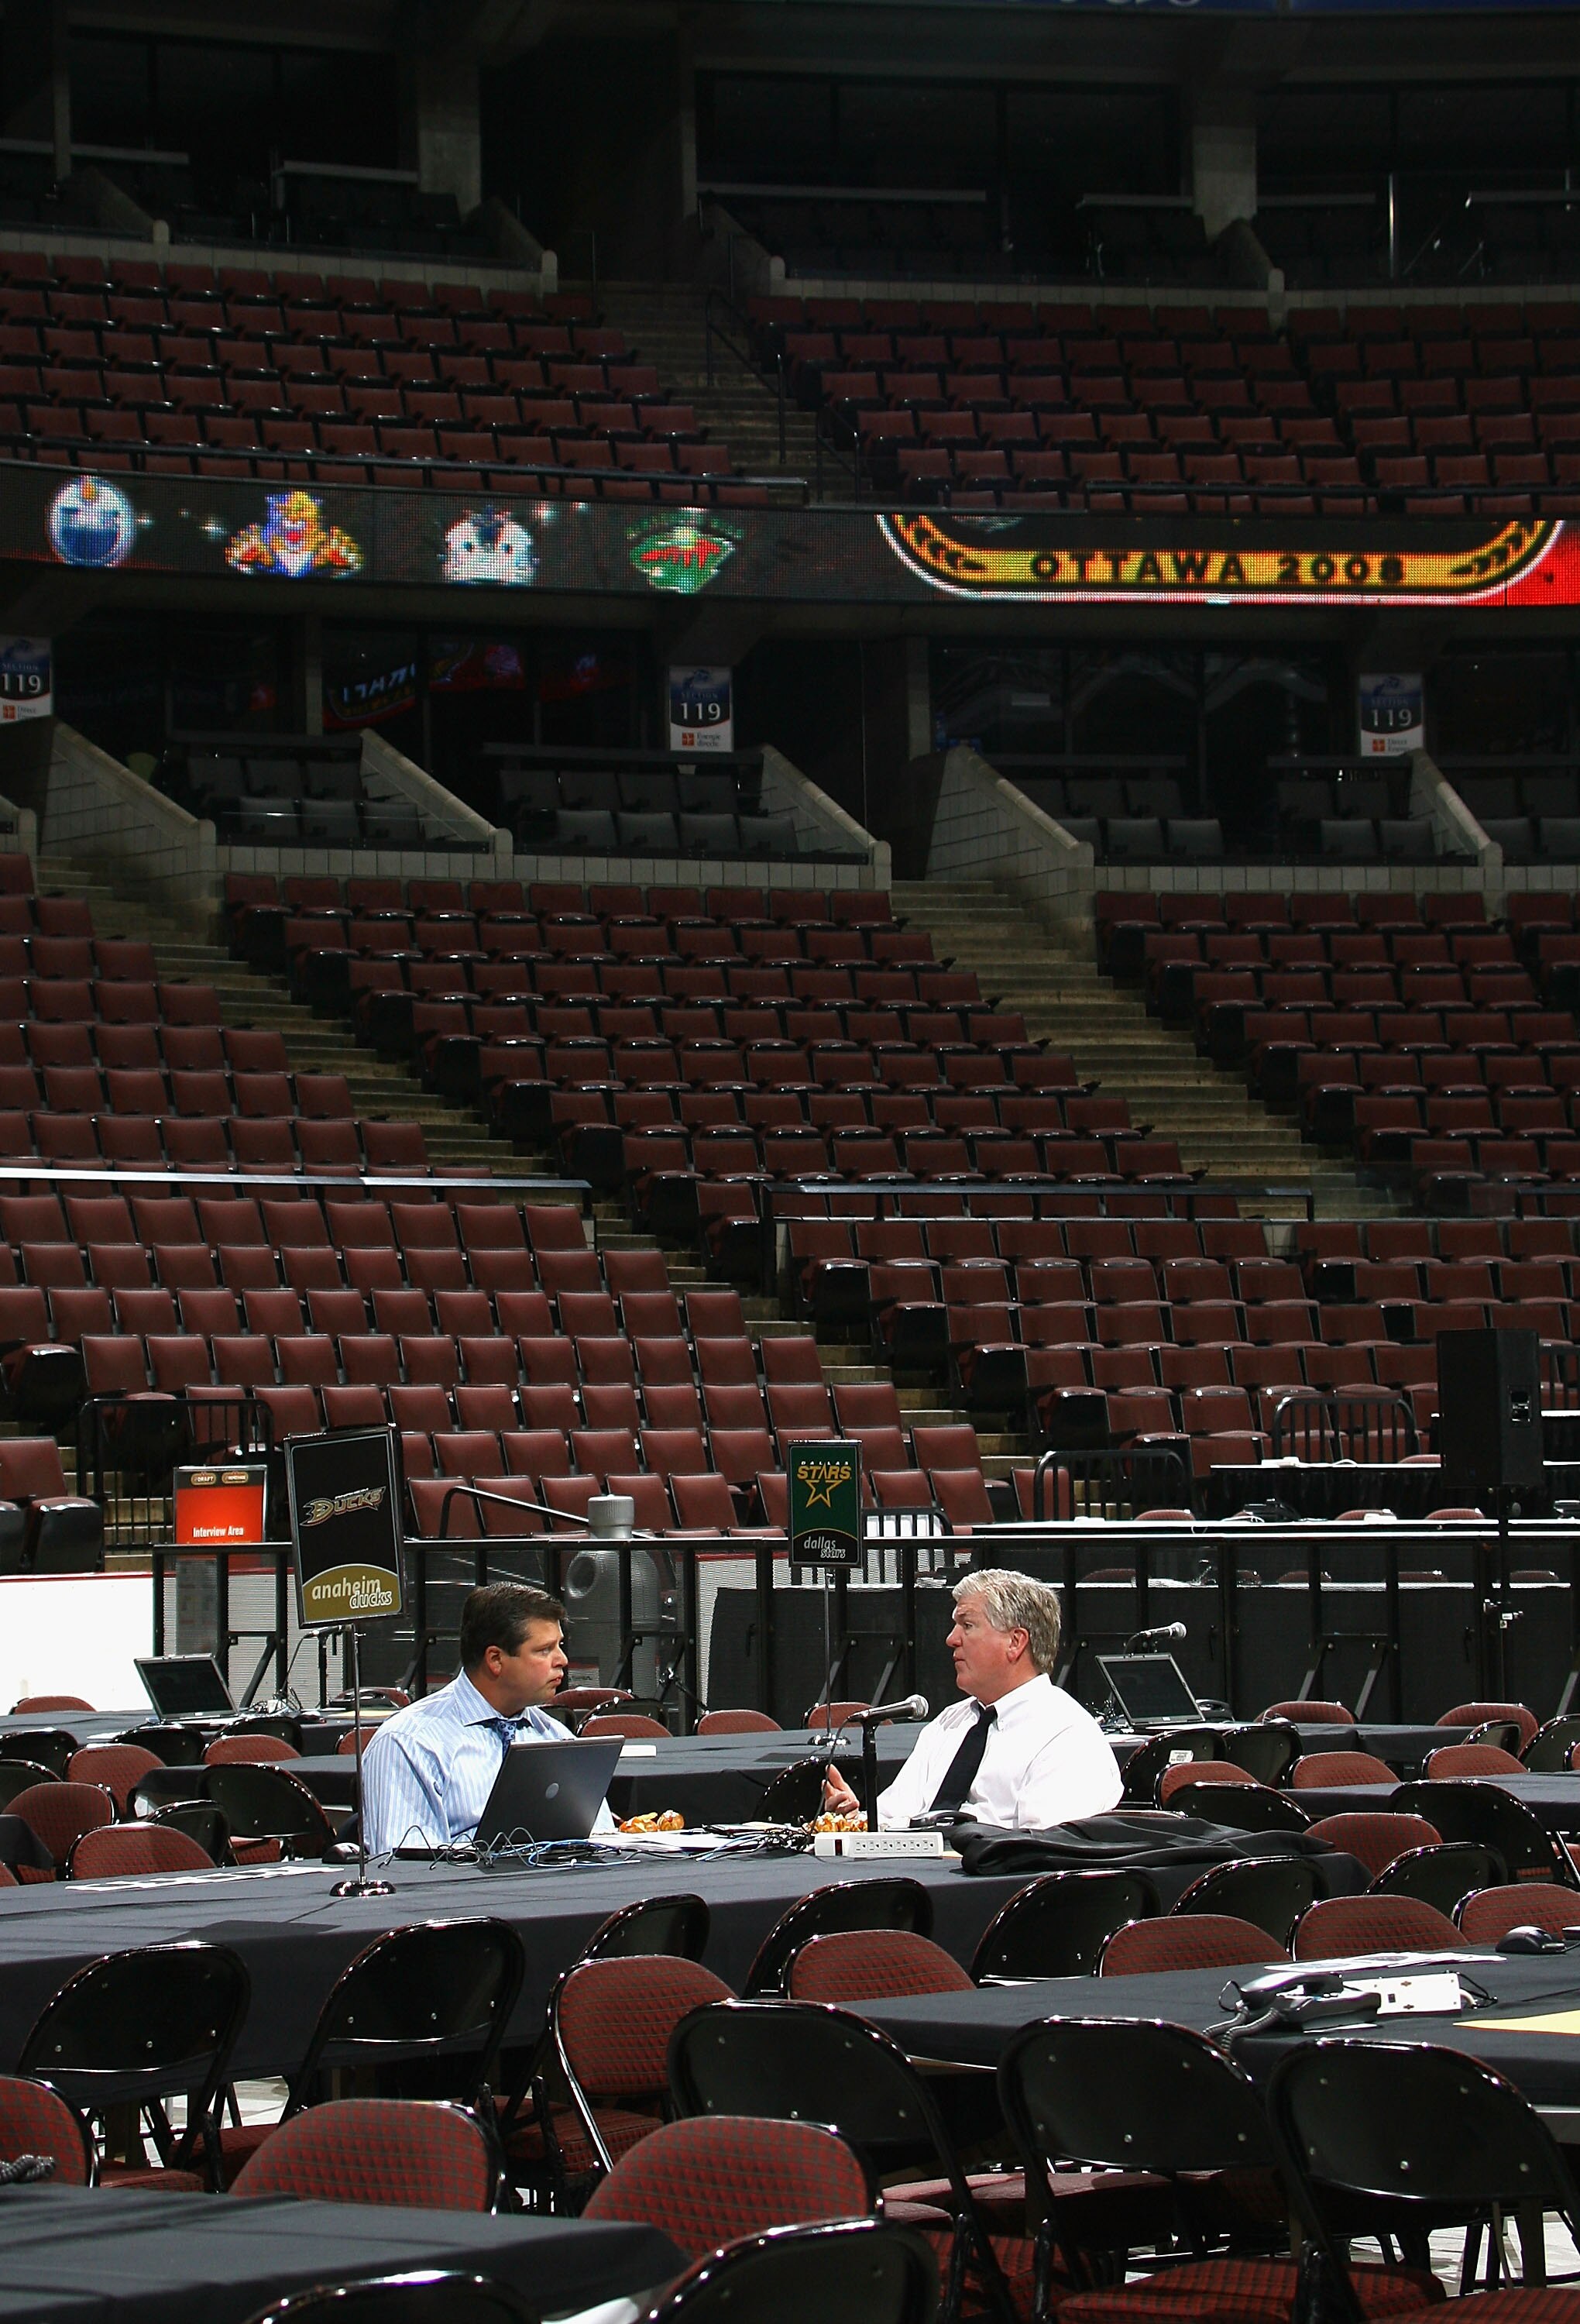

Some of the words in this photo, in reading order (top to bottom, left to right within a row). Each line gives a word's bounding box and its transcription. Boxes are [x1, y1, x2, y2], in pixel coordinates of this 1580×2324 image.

[1031, 552, 1241, 583] OTTAWA
[1279, 555, 1403, 584] 2008
[2, 673, 41, 693] 119
[681, 702, 721, 720] 119
[1372, 709, 1412, 727] 119
[797, 1463, 852, 1480] STARS
[300, 1487, 386, 1526] DUCKS
[193, 1526, 226, 1538] Interview
[228, 1525, 244, 1536] Area
[804, 1536, 836, 1549] dallas
[820, 1547, 846, 1559] stars
[311, 1576, 380, 1600] anaheim
[349, 1587, 393, 1609] ducks
